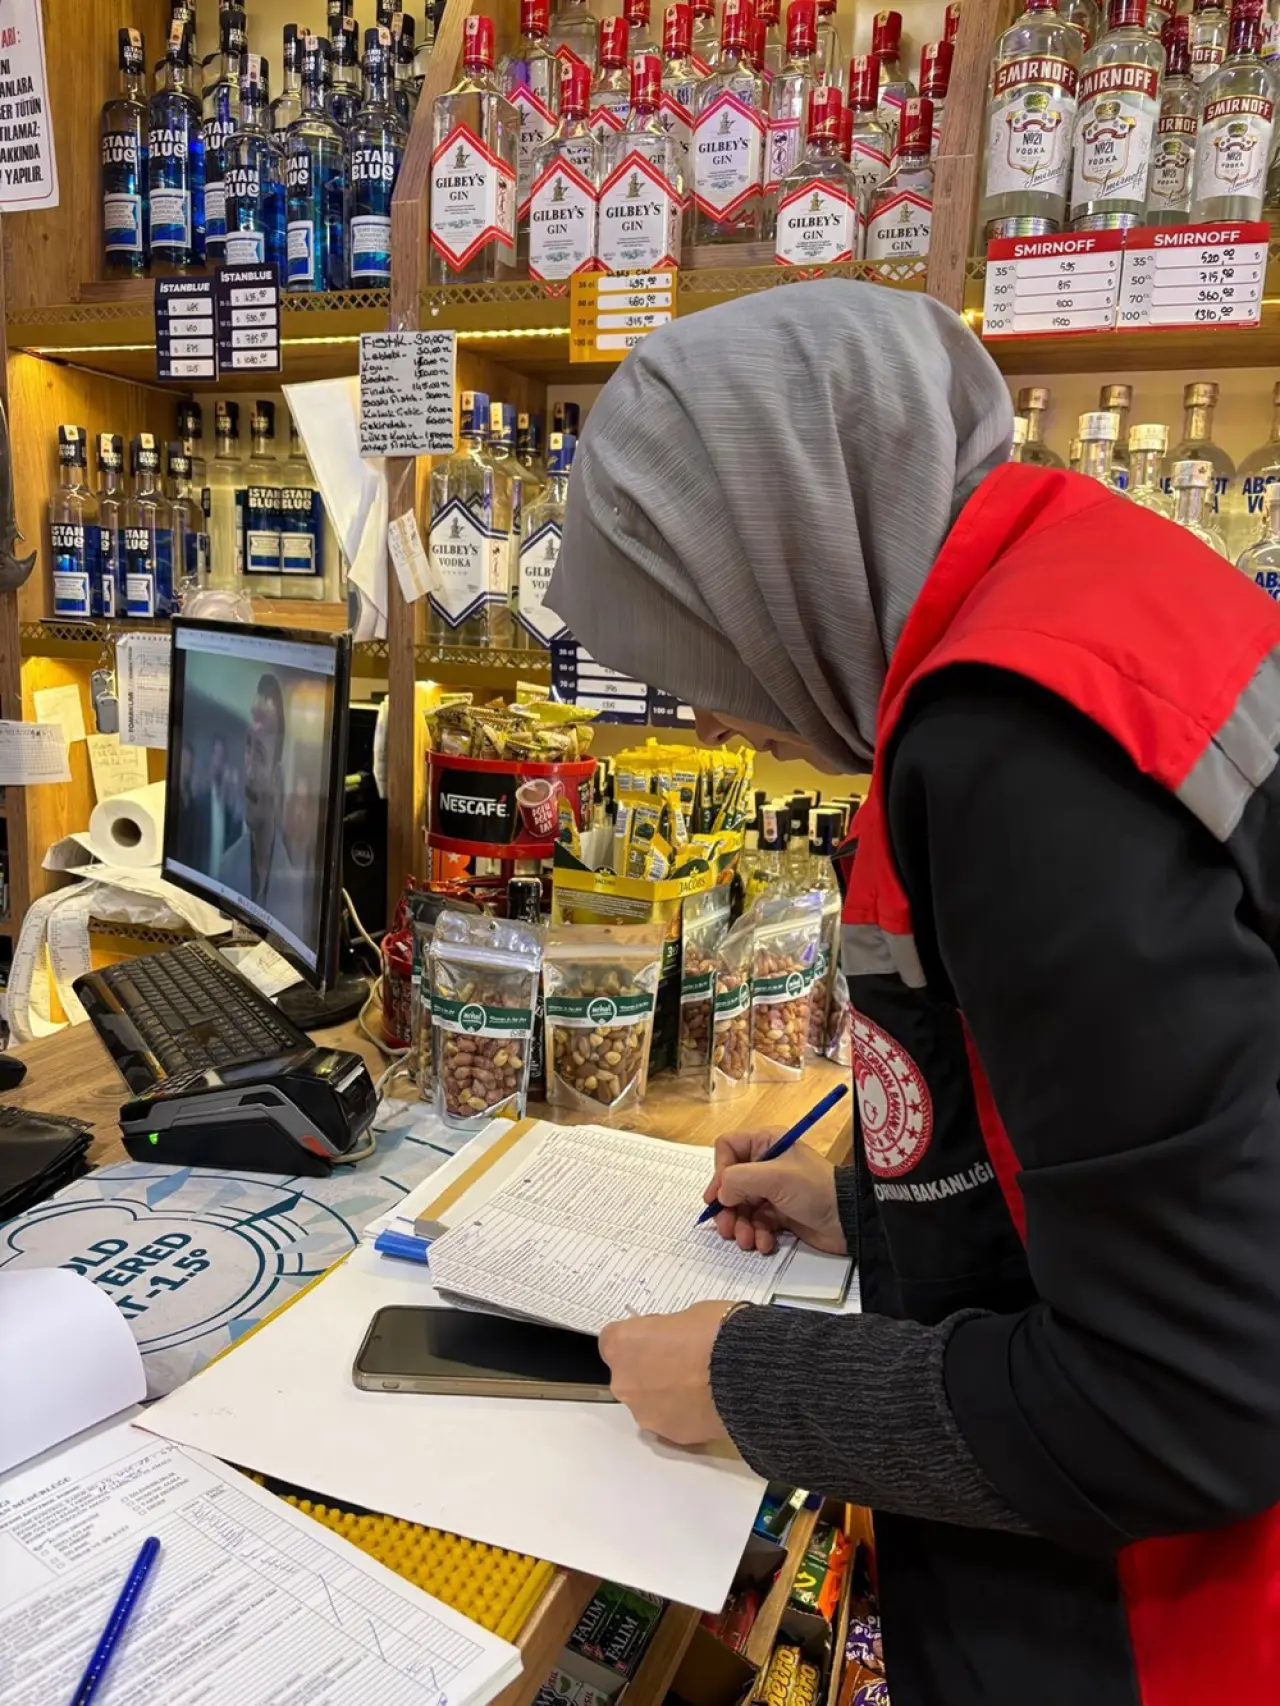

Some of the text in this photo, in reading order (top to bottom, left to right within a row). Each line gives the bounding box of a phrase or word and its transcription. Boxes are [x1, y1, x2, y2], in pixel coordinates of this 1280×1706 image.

[999, 61, 1076, 88] SMIRNOFF
[15, 97, 41, 118] TÜTÜN
[1207, 100, 1270, 120] SMIRNOFF
[698, 138, 749, 154] GILBEY'S
[1016, 147, 1046, 155] VODKA
[712, 154, 733, 165] GIN
[1088, 156, 1118, 166] VODKA
[436, 173, 485, 189] GILBEY'S
[449, 190, 469, 201] GIN
[533, 205, 585, 222] GILBEY'S
[606, 202, 661, 219] GILBEY'S
[621, 220, 644, 232] GIN
[788, 213, 841, 229] GILBEY'S
[547, 224, 568, 235] GIN
[803, 229, 824, 240] GIN
[877, 224, 929, 241] GILBEY'S
[892, 241, 913, 251] GIN
[1154, 230, 1241, 247] SMIRNOFF
[1014, 239, 1096, 257] SMIRNOFF
[432, 543, 479, 555] GILBEY'S
[439, 558, 471, 567] VODKA
[911, 1161, 995, 1202] BAKANLIĞI
[572, 1598, 607, 1643] FALIM
[606, 1615, 639, 1661] FALIM
